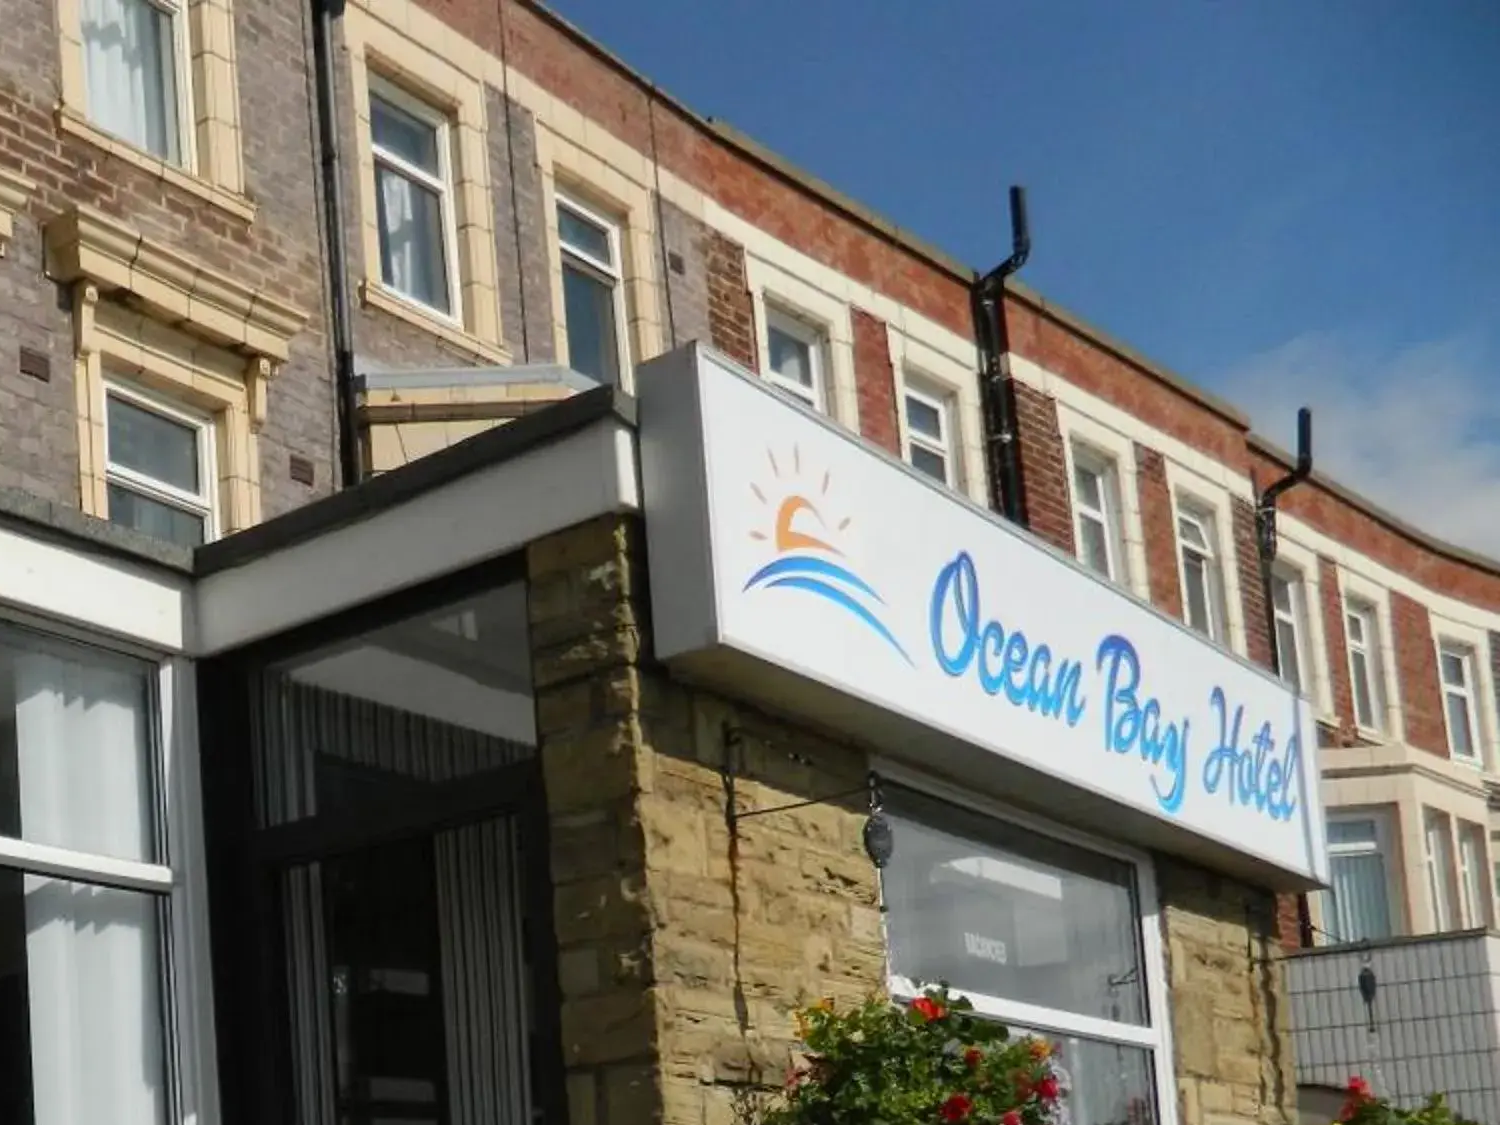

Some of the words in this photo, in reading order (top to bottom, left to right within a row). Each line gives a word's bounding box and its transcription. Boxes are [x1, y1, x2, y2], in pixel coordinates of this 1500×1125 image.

[929, 550, 1086, 729] Ocean
[1096, 633, 1190, 814] Bay
[1202, 685, 1300, 822] Hotel
